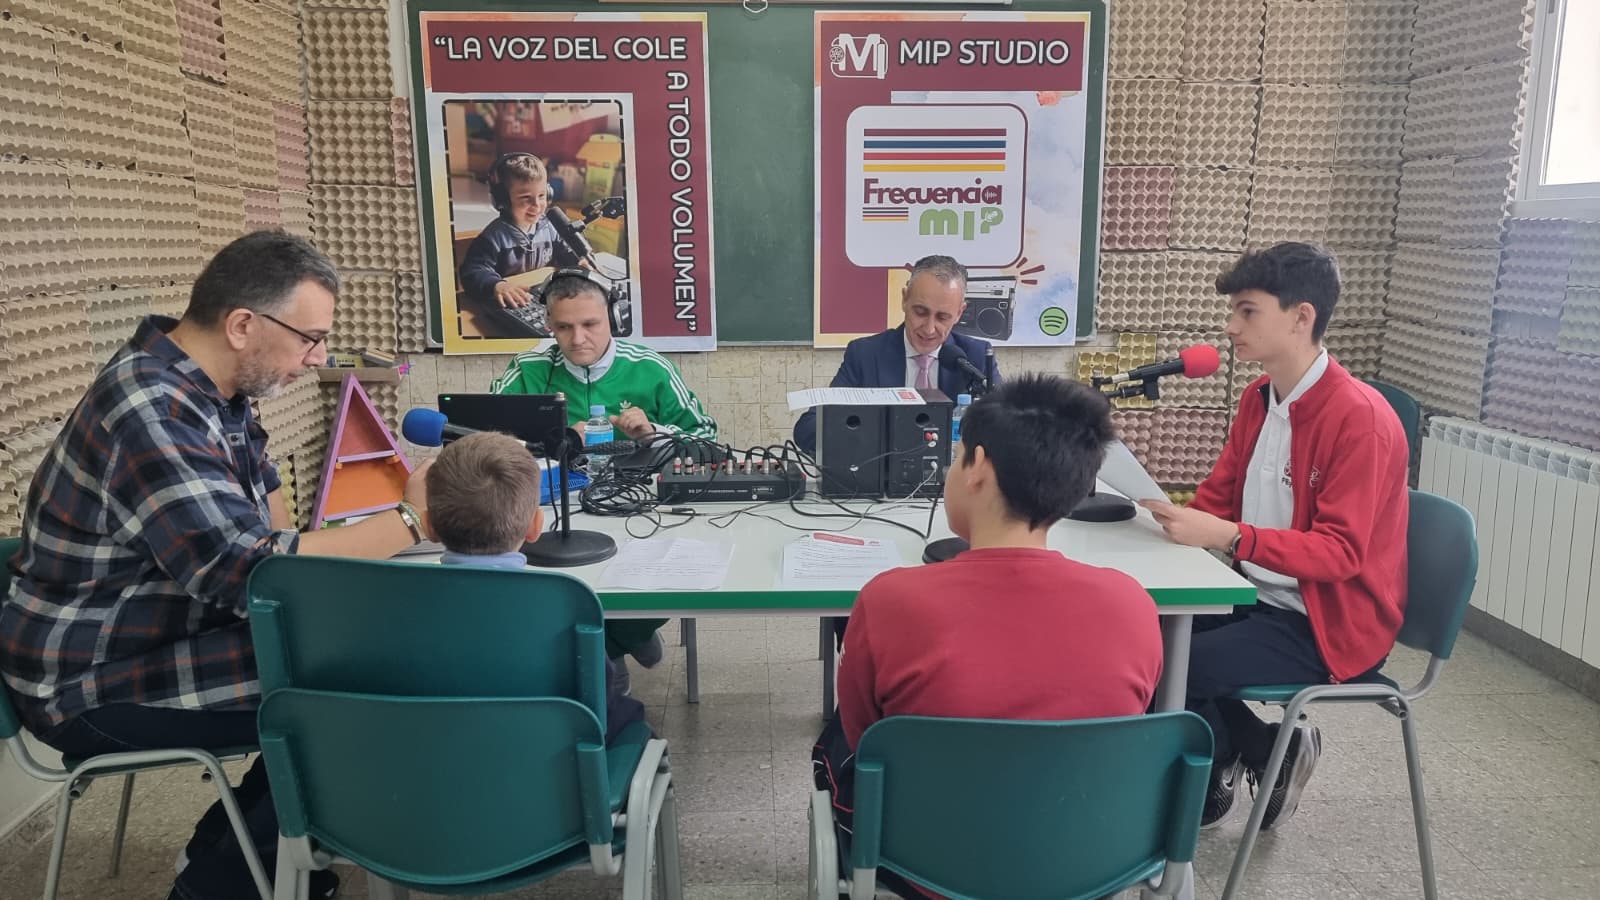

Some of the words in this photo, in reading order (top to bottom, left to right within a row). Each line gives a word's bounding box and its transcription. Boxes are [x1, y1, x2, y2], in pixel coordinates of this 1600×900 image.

[488, 37, 547, 60] VOZ
[554, 37, 607, 60] DEL
[613, 37, 688, 60] COLE
[899, 39, 952, 66] MIP
[958, 39, 1071, 66] STUDIO
[666, 71, 689, 91] A
[667, 97, 692, 182] TODO
[863, 177, 1003, 206] Frecuencia
